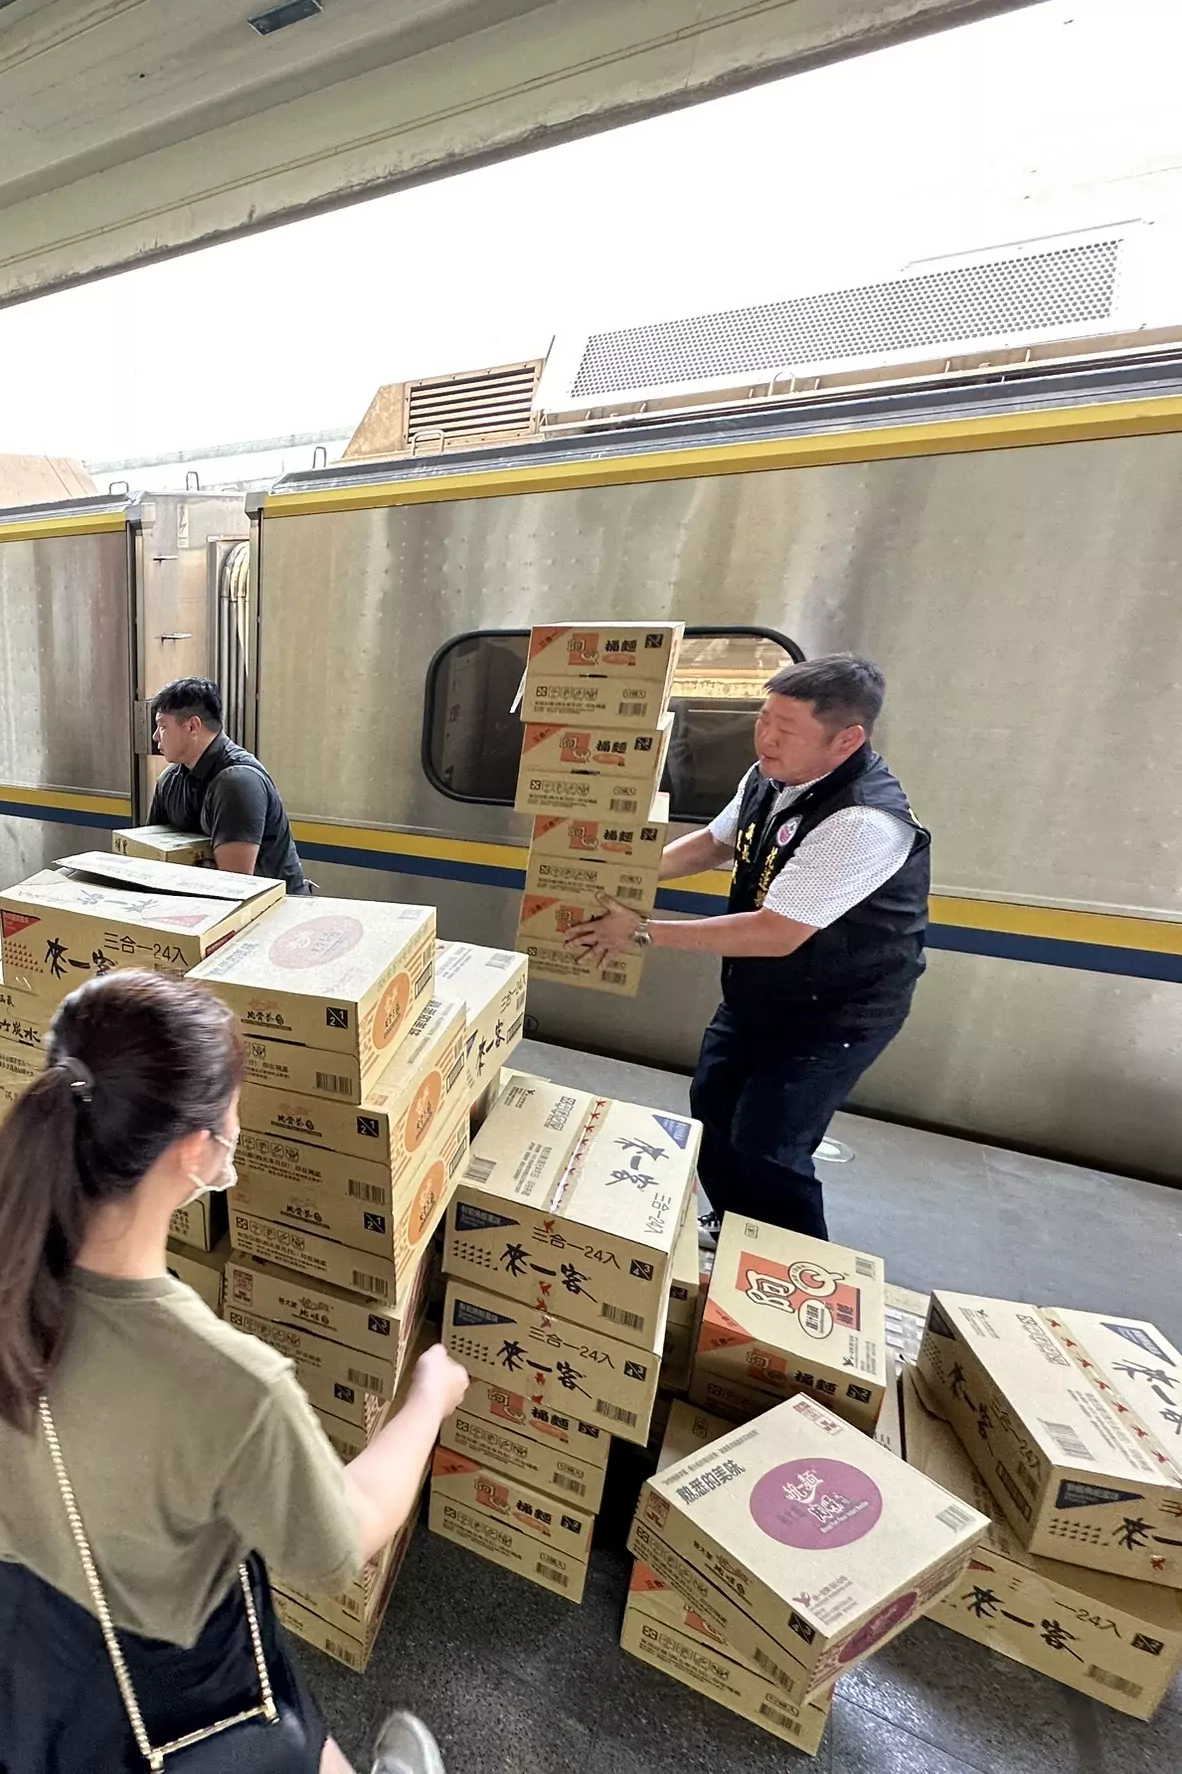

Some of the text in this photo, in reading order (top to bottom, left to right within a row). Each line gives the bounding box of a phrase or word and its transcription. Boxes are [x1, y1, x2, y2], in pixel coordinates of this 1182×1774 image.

[605, 639, 638, 652] 桶麵
[596, 740, 628, 753] 桶麵
[603, 829, 634, 842] 桶麵
[103, 931, 189, 967] 三合一24入
[476, 1018, 506, 1078] 來一客
[605, 1136, 669, 1193] 來一客
[644, 1191, 672, 1235] 三合一24入
[531, 1226, 620, 1270] 三合一24入
[499, 1242, 598, 1304] 來一客
[745, 1261, 845, 1314] 阿Q
[496, 1339, 593, 1400] 來一客
[528, 1325, 615, 1370] 三合一24入
[793, 1370, 839, 1396] 桶麵
[530, 1406, 570, 1432] 桶麵
[675, 1459, 746, 1505] 熟悉的美味
[516, 1499, 552, 1526] 桶麵
[961, 1584, 1085, 1664] 來一客
[1008, 1576, 1122, 1639] 三一24入
